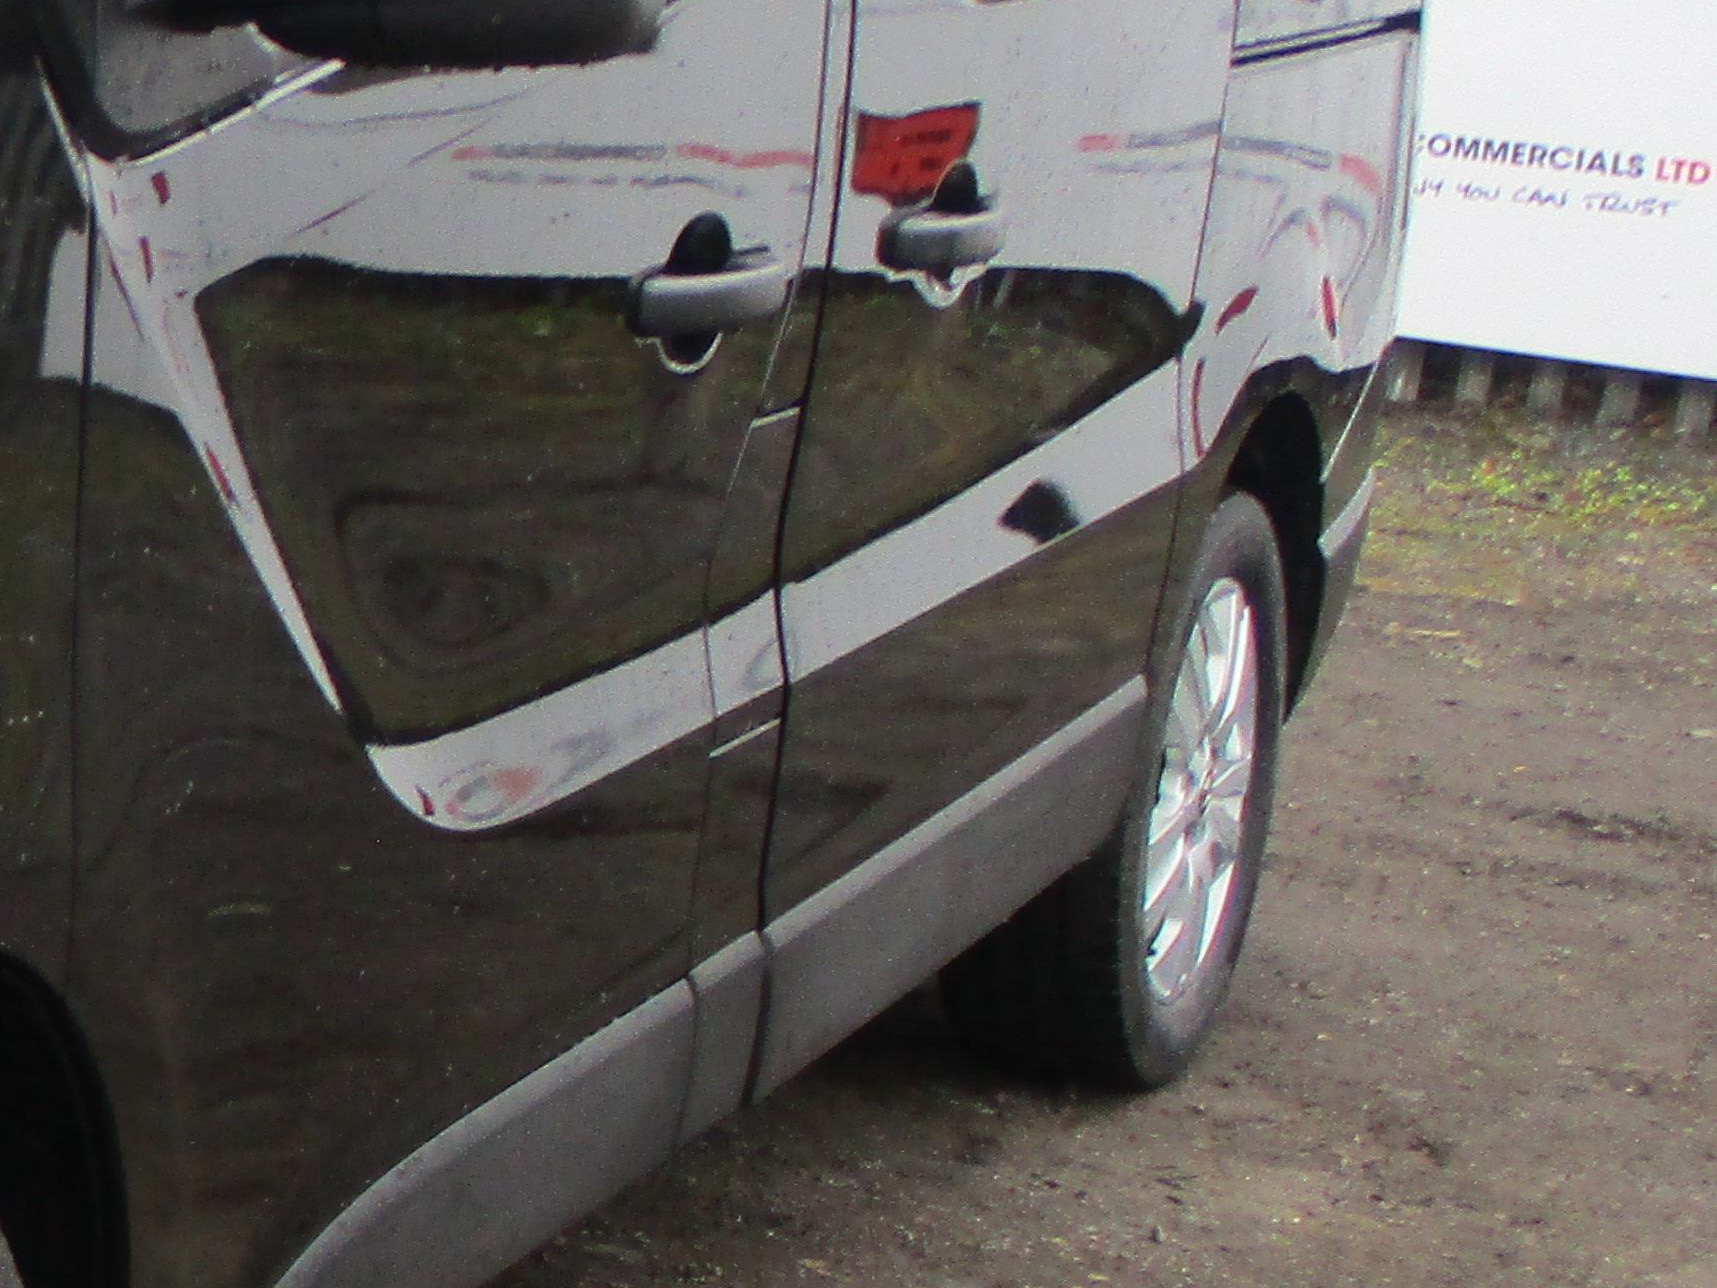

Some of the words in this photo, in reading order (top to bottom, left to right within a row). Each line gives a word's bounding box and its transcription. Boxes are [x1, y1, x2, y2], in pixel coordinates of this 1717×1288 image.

[1654, 155, 1712, 185] LTD
[1455, 179, 1501, 202] YOU
[1511, 185, 1570, 209] CAN
[1581, 190, 1683, 217] TRUST
